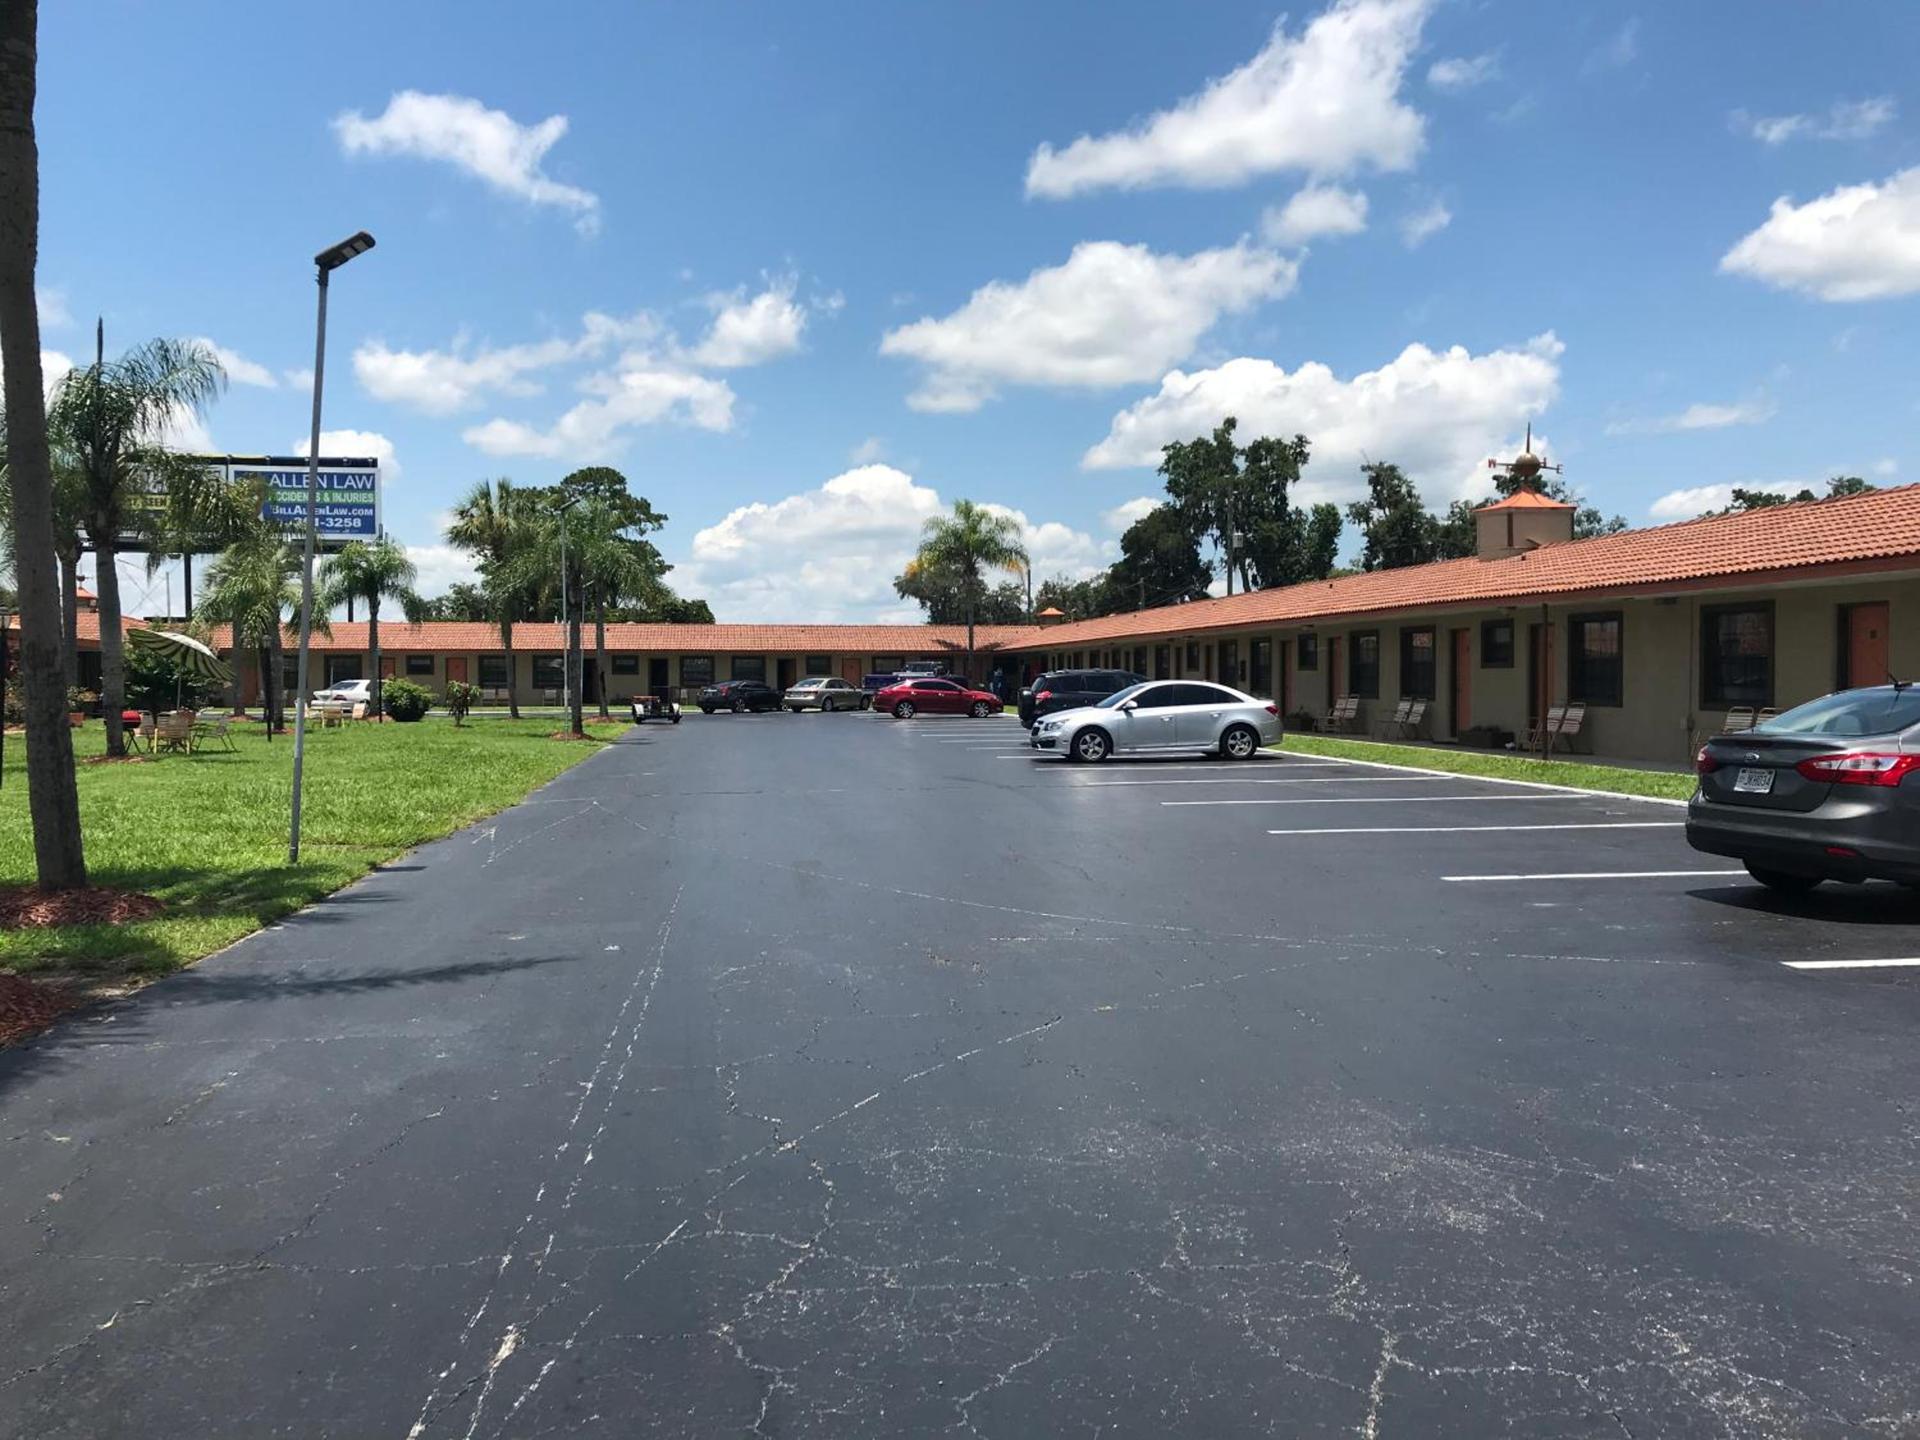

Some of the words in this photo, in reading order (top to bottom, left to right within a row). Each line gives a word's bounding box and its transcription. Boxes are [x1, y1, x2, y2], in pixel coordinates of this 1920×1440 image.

[269, 473, 327, 489] ALLEN
[333, 474, 373, 489] LAW
[268, 491, 321, 502] CCIDENS
[323, 491, 331, 502] &
[332, 491, 374, 503] INJURIES
